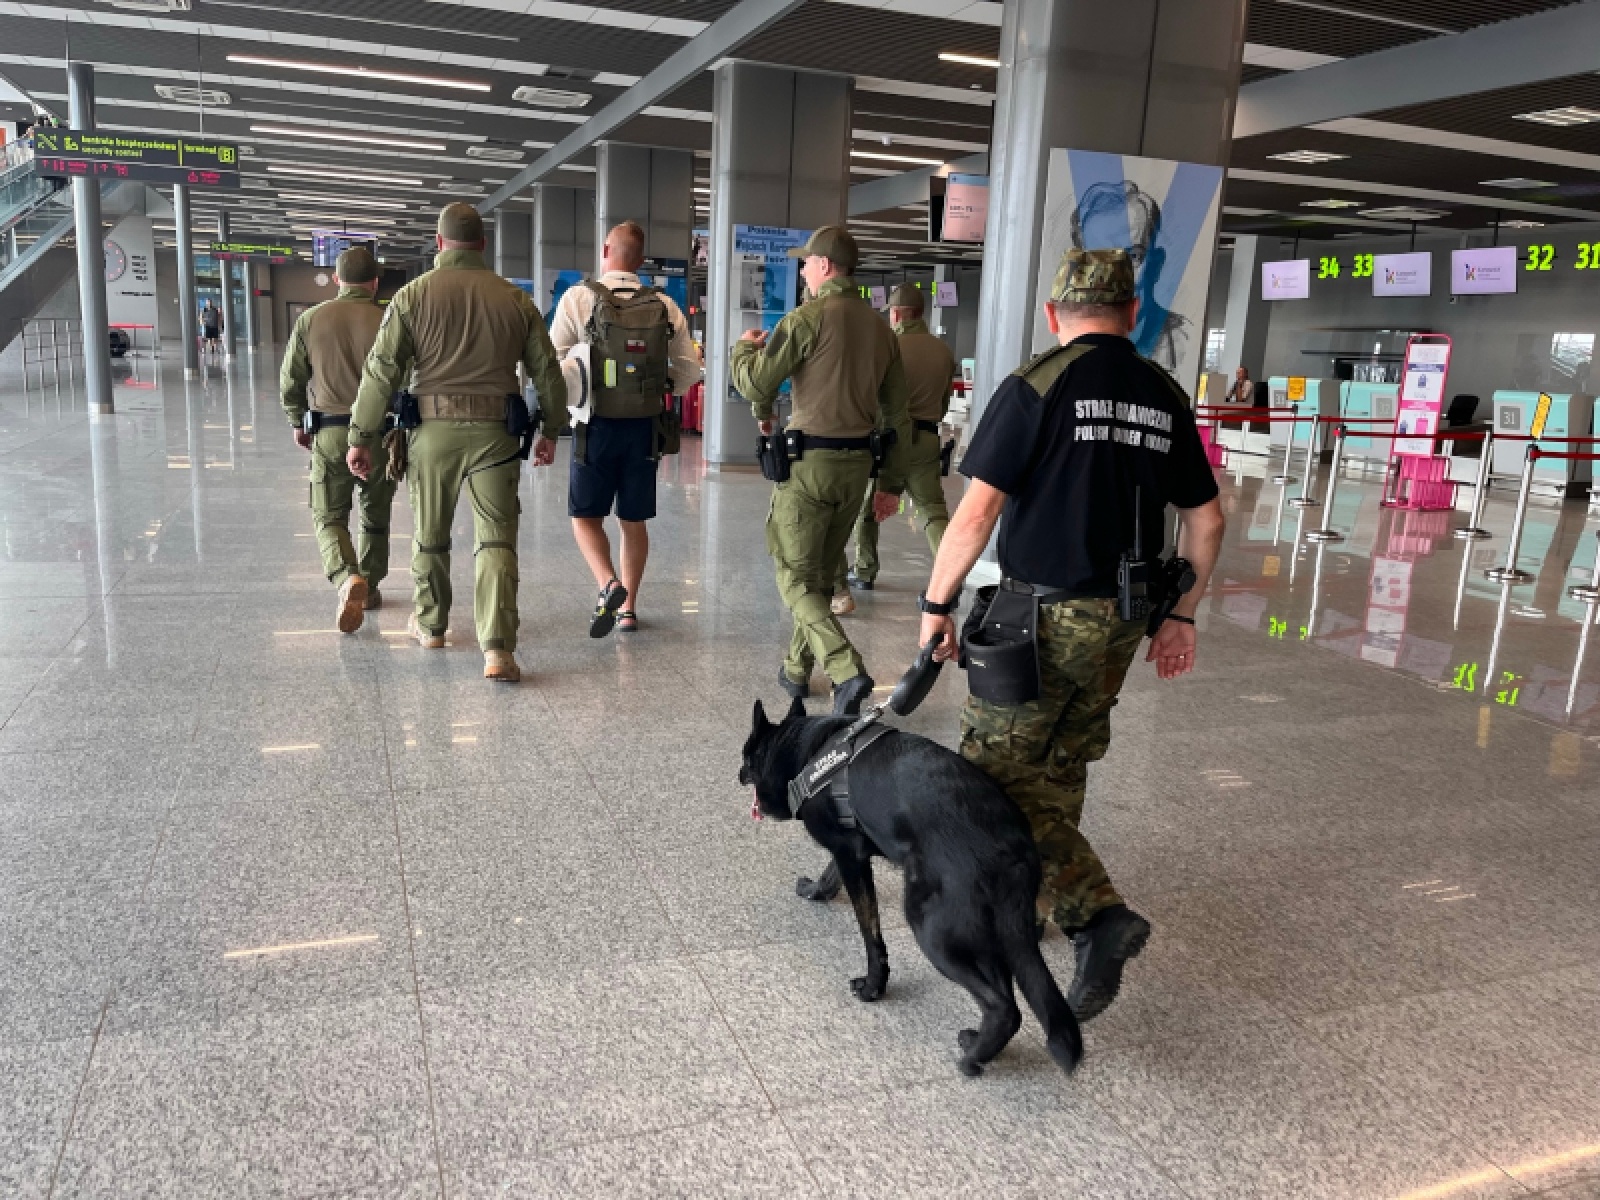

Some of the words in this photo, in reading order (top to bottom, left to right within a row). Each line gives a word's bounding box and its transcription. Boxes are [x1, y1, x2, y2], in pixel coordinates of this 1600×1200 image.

[1317, 256, 1340, 279] 34
[1351, 253, 1374, 278] 33
[1525, 244, 1555, 271] 32
[1574, 242, 1600, 270] 31
[1503, 411, 1516, 425] 31
